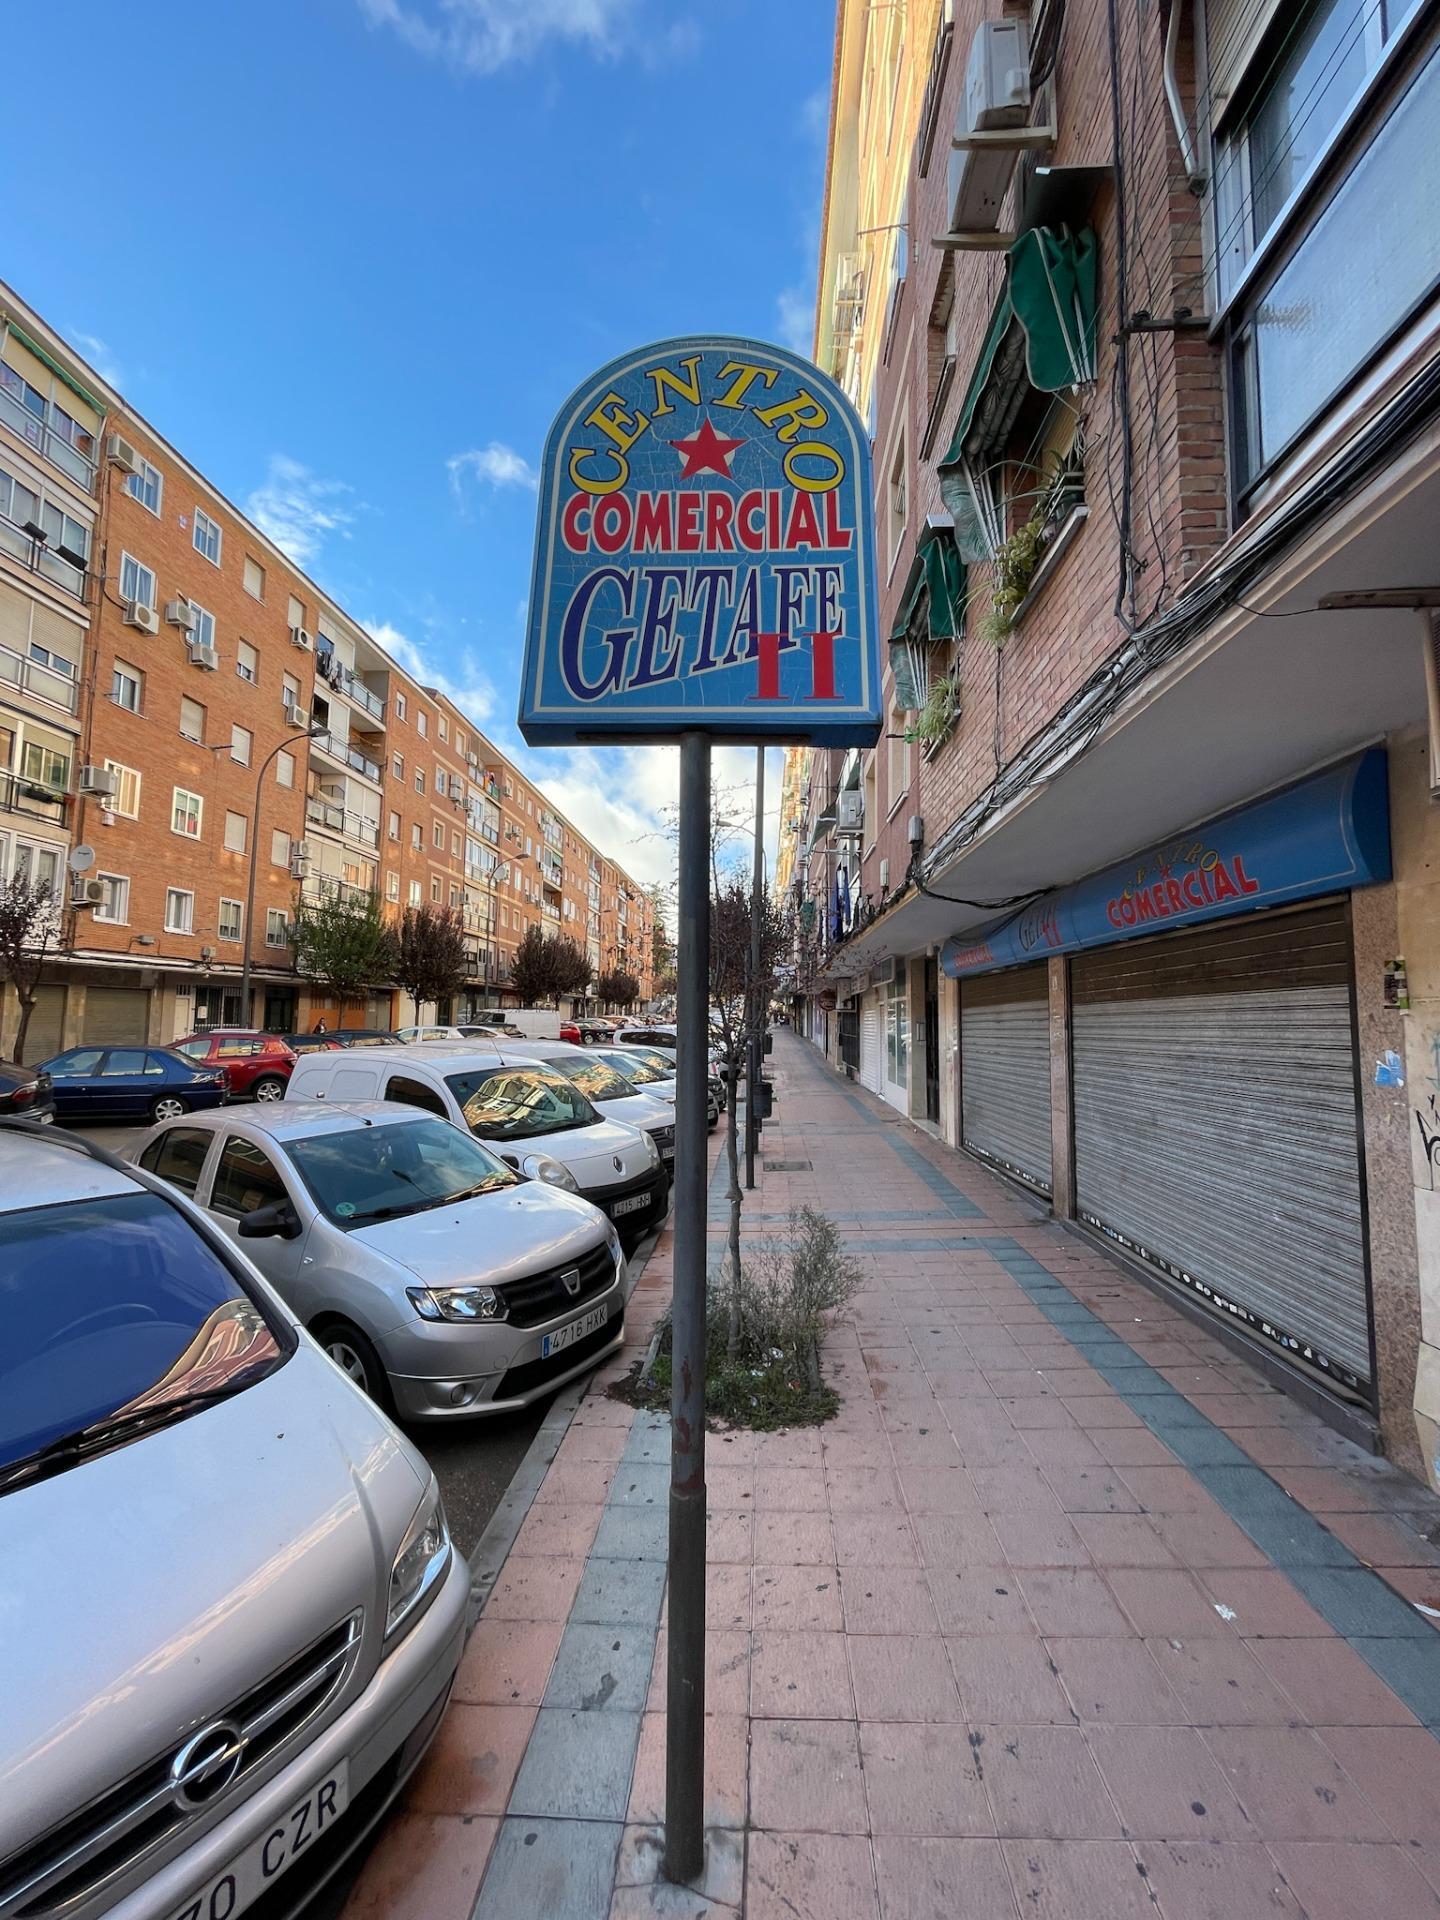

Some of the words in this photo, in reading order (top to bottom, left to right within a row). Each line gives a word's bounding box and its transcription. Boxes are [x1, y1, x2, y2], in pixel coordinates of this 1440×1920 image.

[568, 356, 846, 496] CENTRO
[562, 490, 856, 554] COMERCIAL
[561, 567, 845, 702] GETAFE
[748, 633, 845, 700] II
[1106, 855, 1260, 929] COMERCIAL
[552, 1321, 583, 1349] 4716
[586, 1306, 606, 1332] HXK
[262, 1779, 337, 1877] CZR
